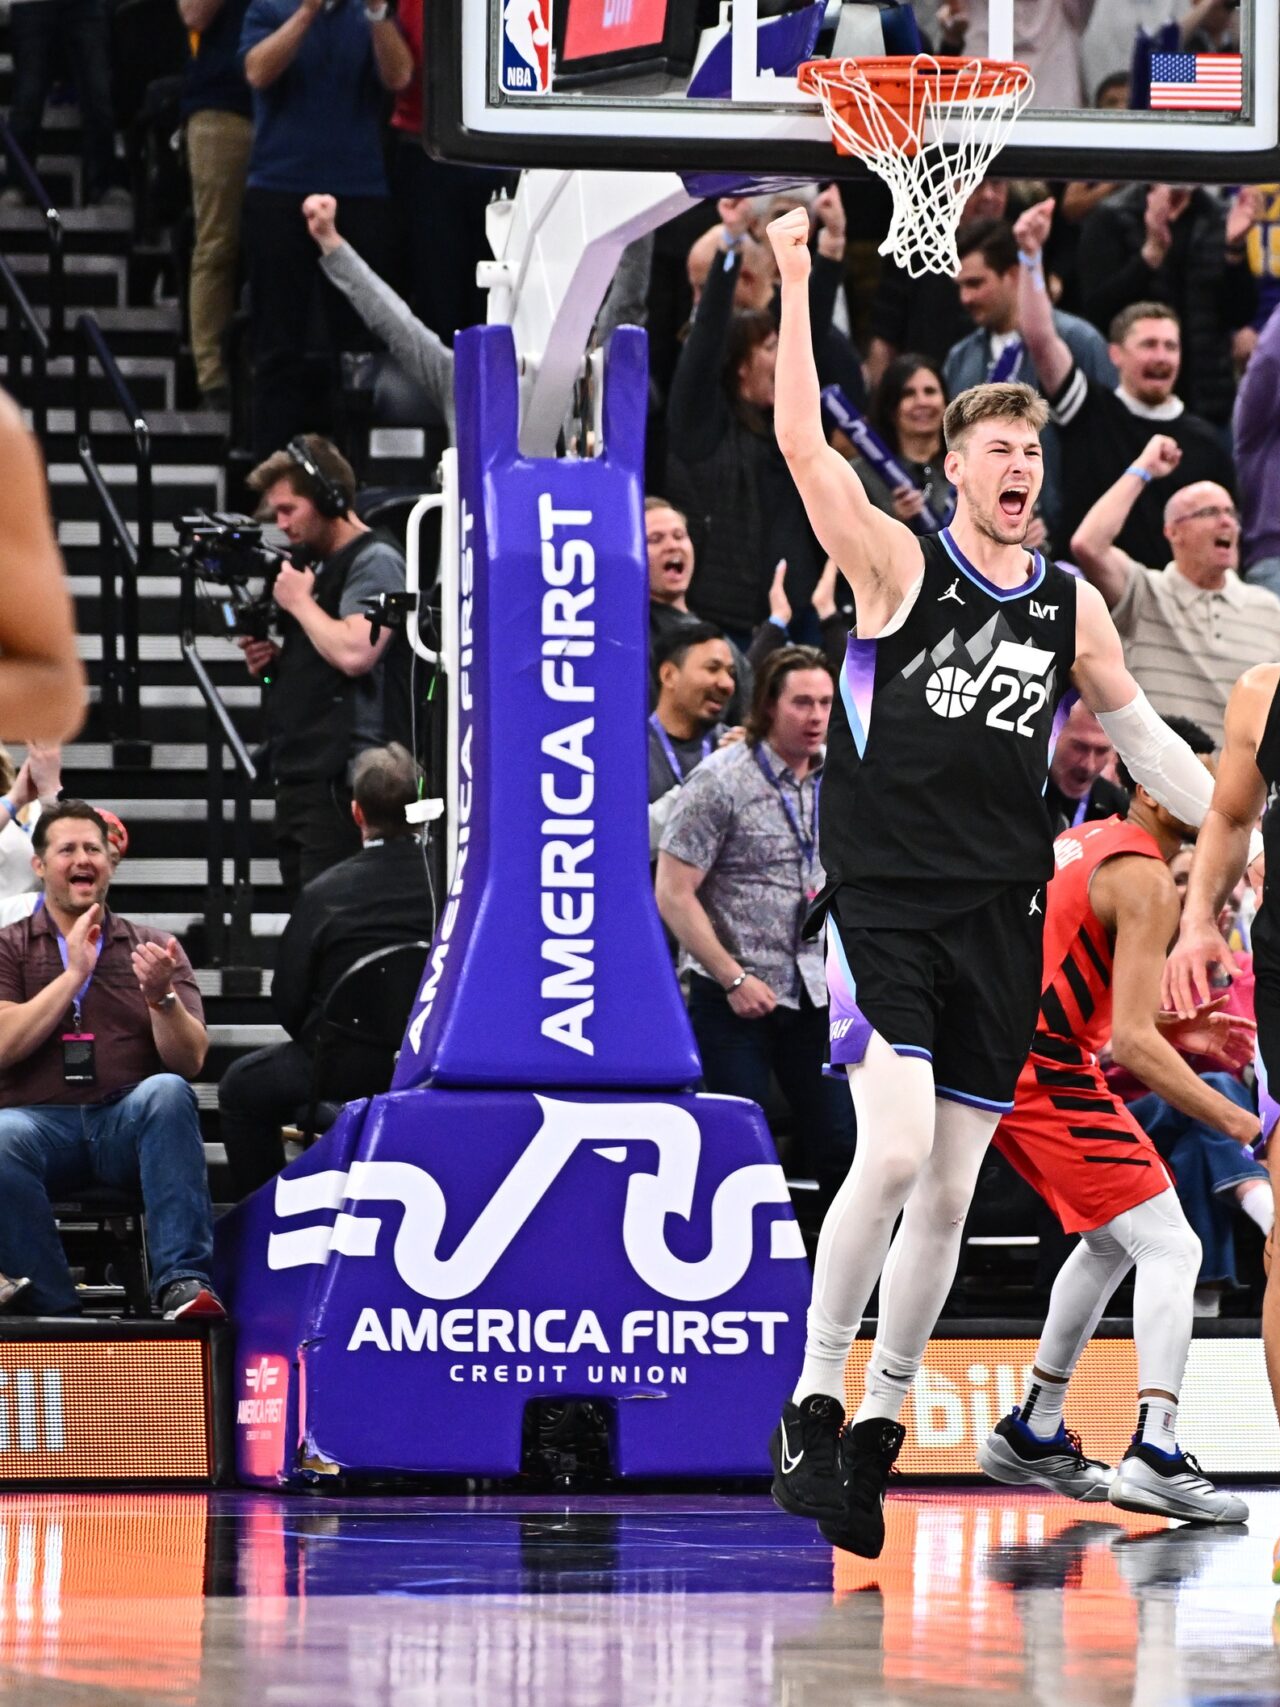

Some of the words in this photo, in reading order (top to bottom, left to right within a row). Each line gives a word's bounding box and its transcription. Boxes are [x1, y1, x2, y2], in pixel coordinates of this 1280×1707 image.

[507, 67, 532, 87] NBA
[538, 493, 595, 702] FIRST
[1029, 600, 1060, 621] LVT
[985, 674, 1046, 738] 22
[408, 724, 473, 1055] AMERICA
[461, 498, 474, 711] FIRST
[541, 716, 595, 1057] AMERICA
[347, 1307, 610, 1354] AMERICA
[622, 1310, 790, 1355] FIRST
[450, 1364, 567, 1384] CREDIT
[588, 1365, 687, 1385] UNION
